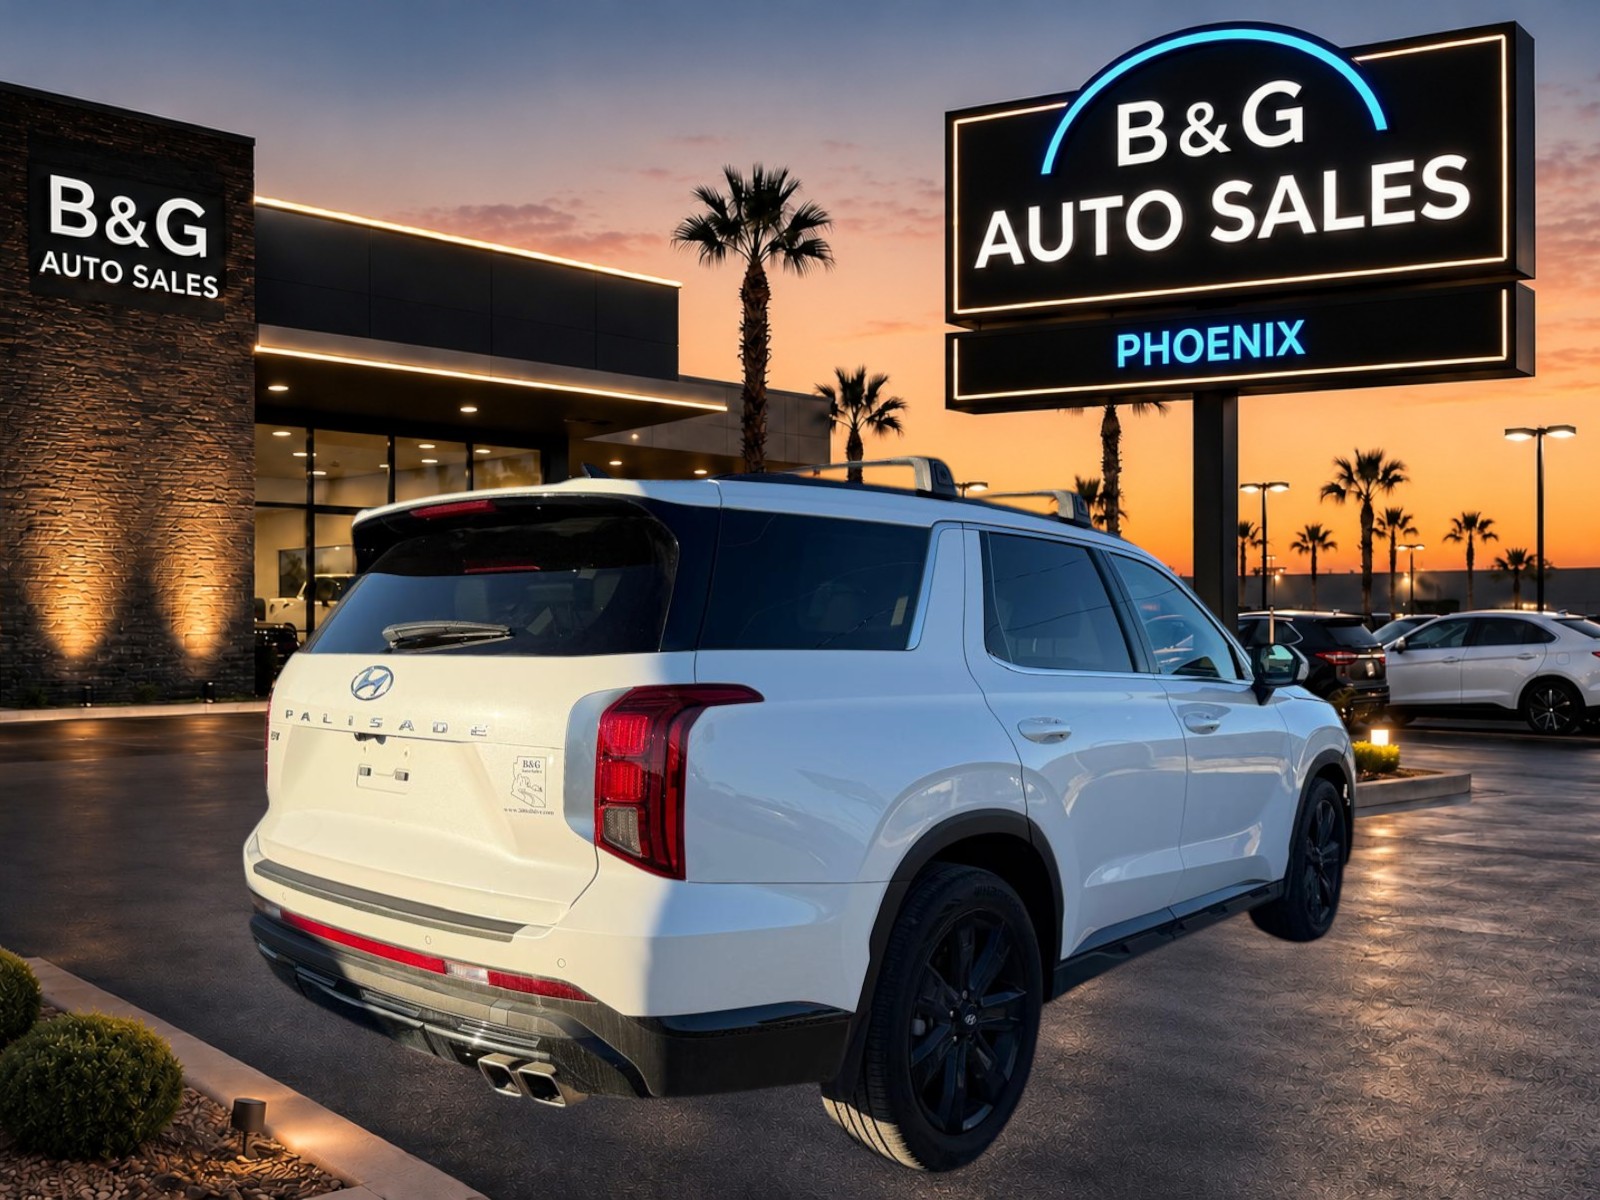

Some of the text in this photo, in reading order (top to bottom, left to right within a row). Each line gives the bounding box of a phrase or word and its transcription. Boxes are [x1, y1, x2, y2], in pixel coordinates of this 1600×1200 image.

[973, 153, 1471, 270] AUTO SALES
[39, 250, 219, 299] AUTO SALES
[1116, 319, 1306, 368] PHOENIX
[285, 708, 489, 737] PALISADE
[523, 760, 541, 769] B&G
